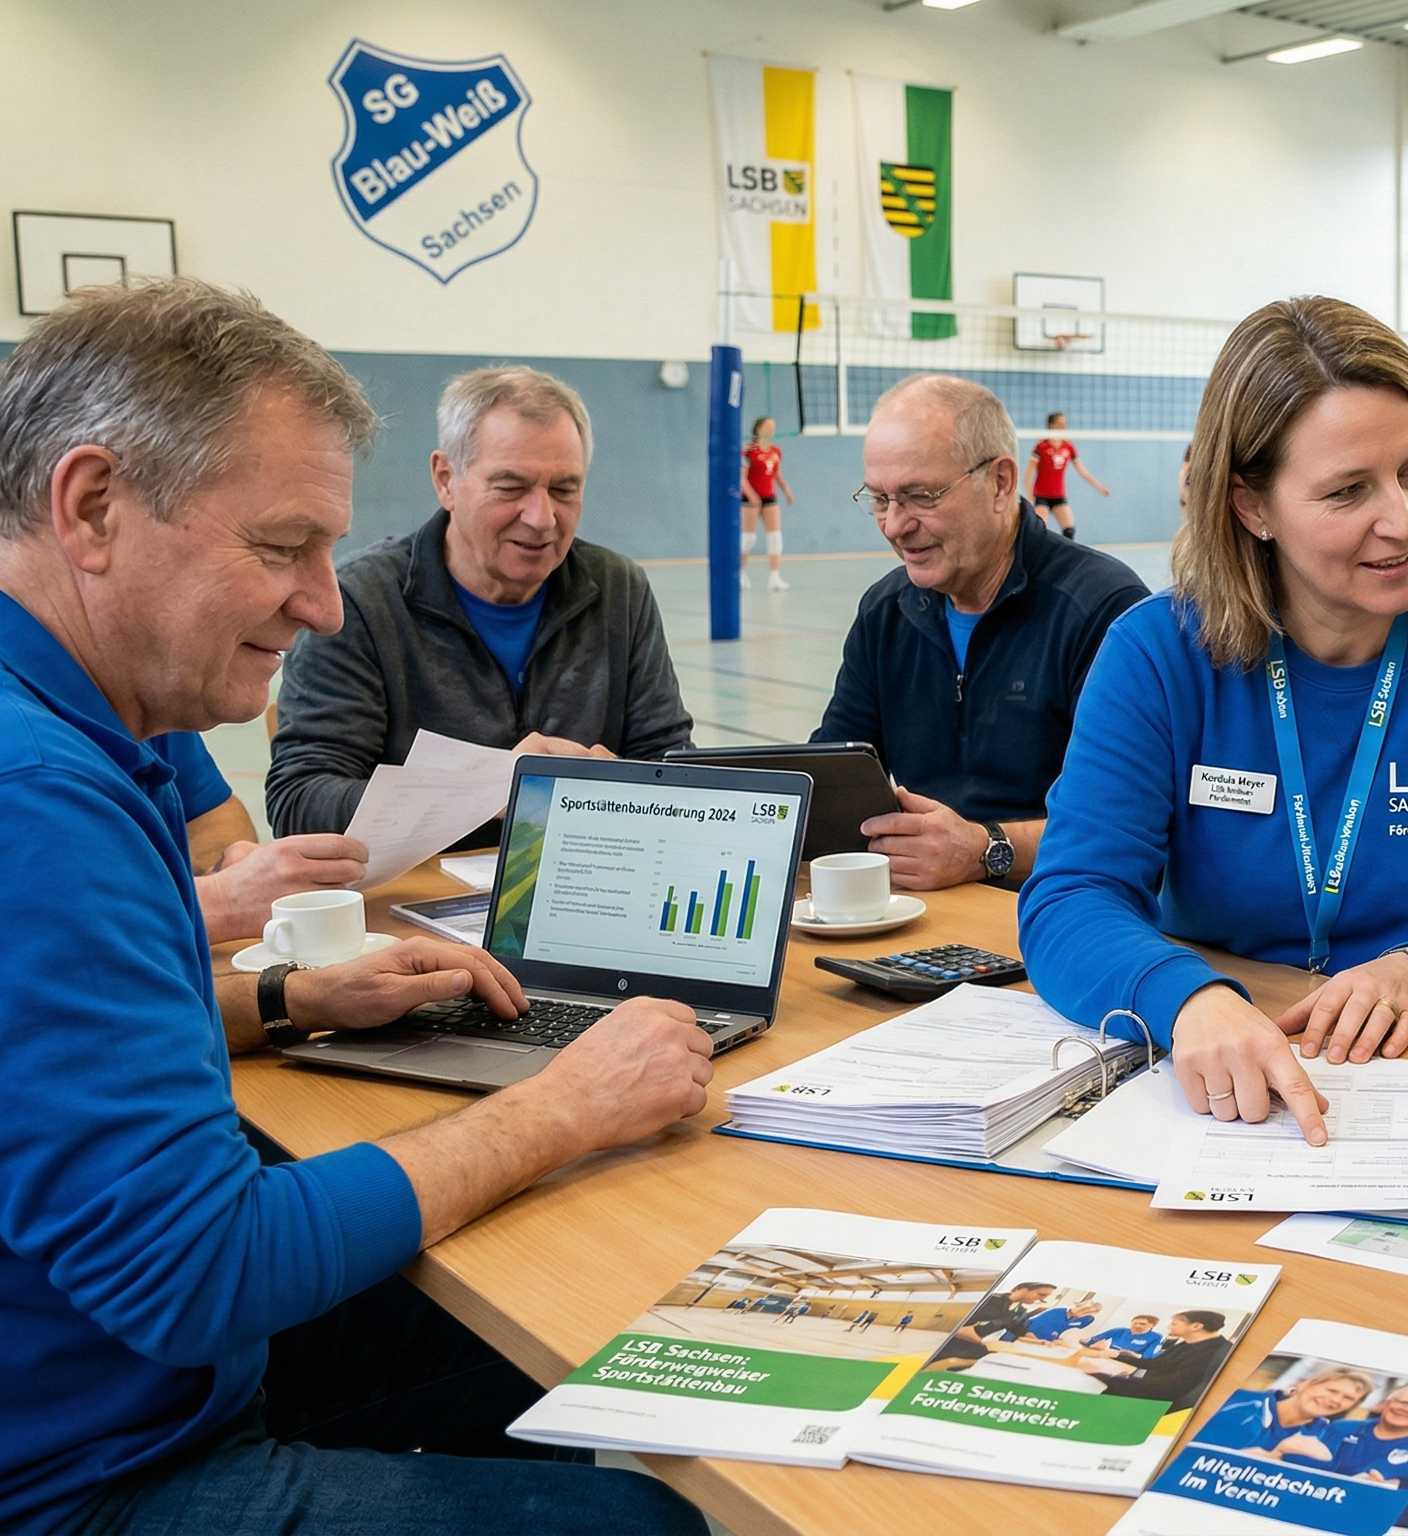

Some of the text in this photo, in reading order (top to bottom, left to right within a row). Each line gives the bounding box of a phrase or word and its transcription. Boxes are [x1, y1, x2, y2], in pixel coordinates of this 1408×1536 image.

[362, 73, 420, 124] SG
[349, 78, 508, 205] Blau-Weiß
[727, 164, 778, 192] LSB
[421, 181, 522, 259] Sachsen
[1368, 700, 1387, 728] LSB
[708, 808, 736, 822] 2024
[752, 802, 776, 817] LSB
[939, 1236, 981, 1247] LSB
[1189, 1270, 1232, 1282] LSB
[664, 1344, 751, 1365] Sachsen:
[922, 1379, 1059, 1411] LSB Sachsen:
[1214, 1479, 1280, 1508] Verein
